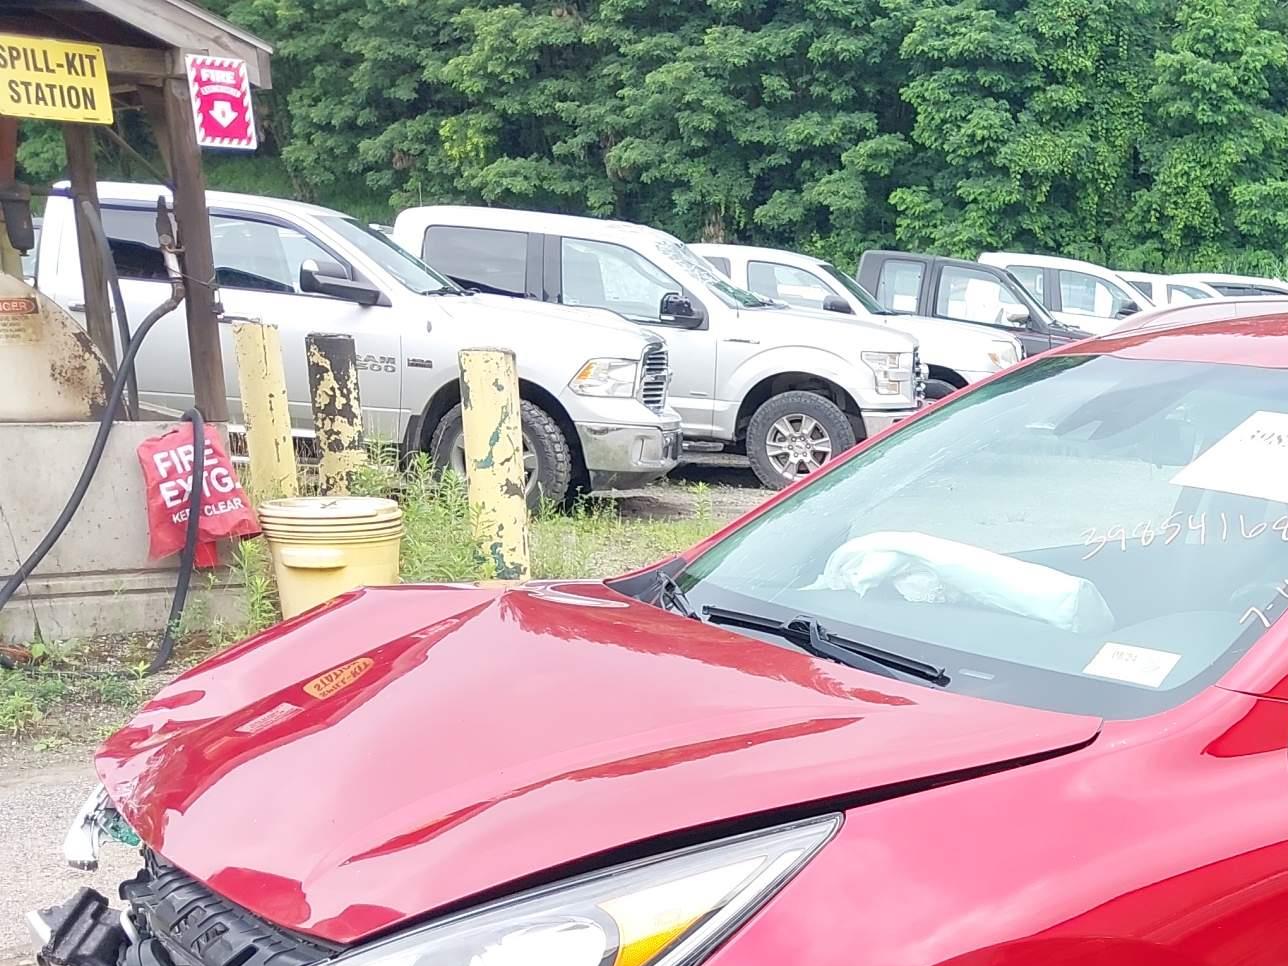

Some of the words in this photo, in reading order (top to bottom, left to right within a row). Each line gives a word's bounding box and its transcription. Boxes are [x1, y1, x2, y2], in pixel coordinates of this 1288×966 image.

[0, 44, 96, 78] SPILL-KIT
[201, 69, 236, 84] FIRE
[8, 80, 96, 110] STATION
[153, 440, 218, 479] FIRE
[204, 497, 245, 516] CLEAR
